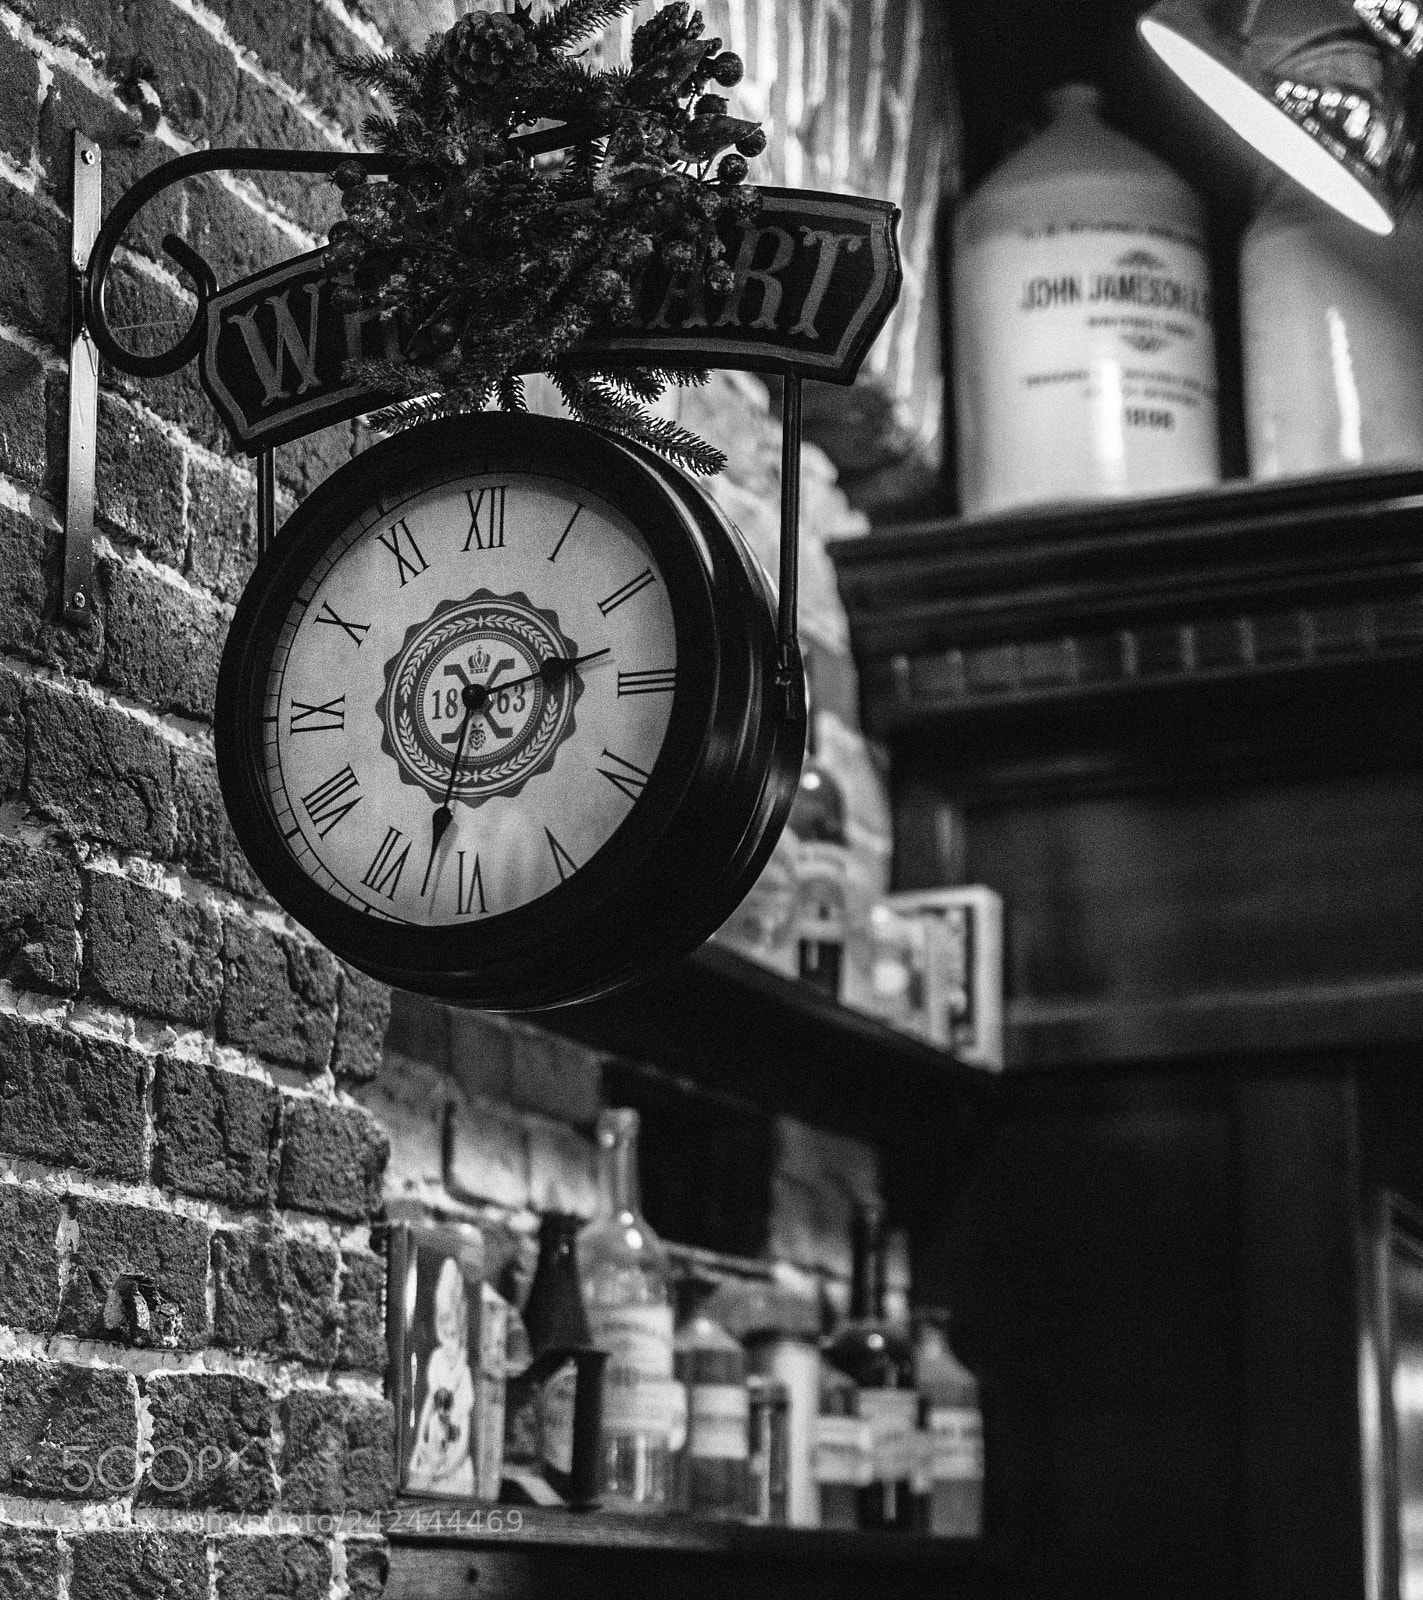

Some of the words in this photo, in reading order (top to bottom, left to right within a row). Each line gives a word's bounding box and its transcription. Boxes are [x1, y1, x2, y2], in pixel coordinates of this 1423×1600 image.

[615, 219, 868, 339] ART
[1020, 276, 1082, 313] JOHN
[461, 485, 508, 551] XII
[547, 503, 585, 562] I
[376, 518, 431, 587] XI
[598, 568, 657, 616] II
[315, 601, 371, 649] X
[618, 668, 677, 699] III
[290, 694, 346, 735] IX
[302, 764, 363, 840] VIII
[596, 749, 651, 800] IV
[361, 827, 413, 901] VII
[545, 826, 578, 882] V
[455, 851, 488, 915] VI
